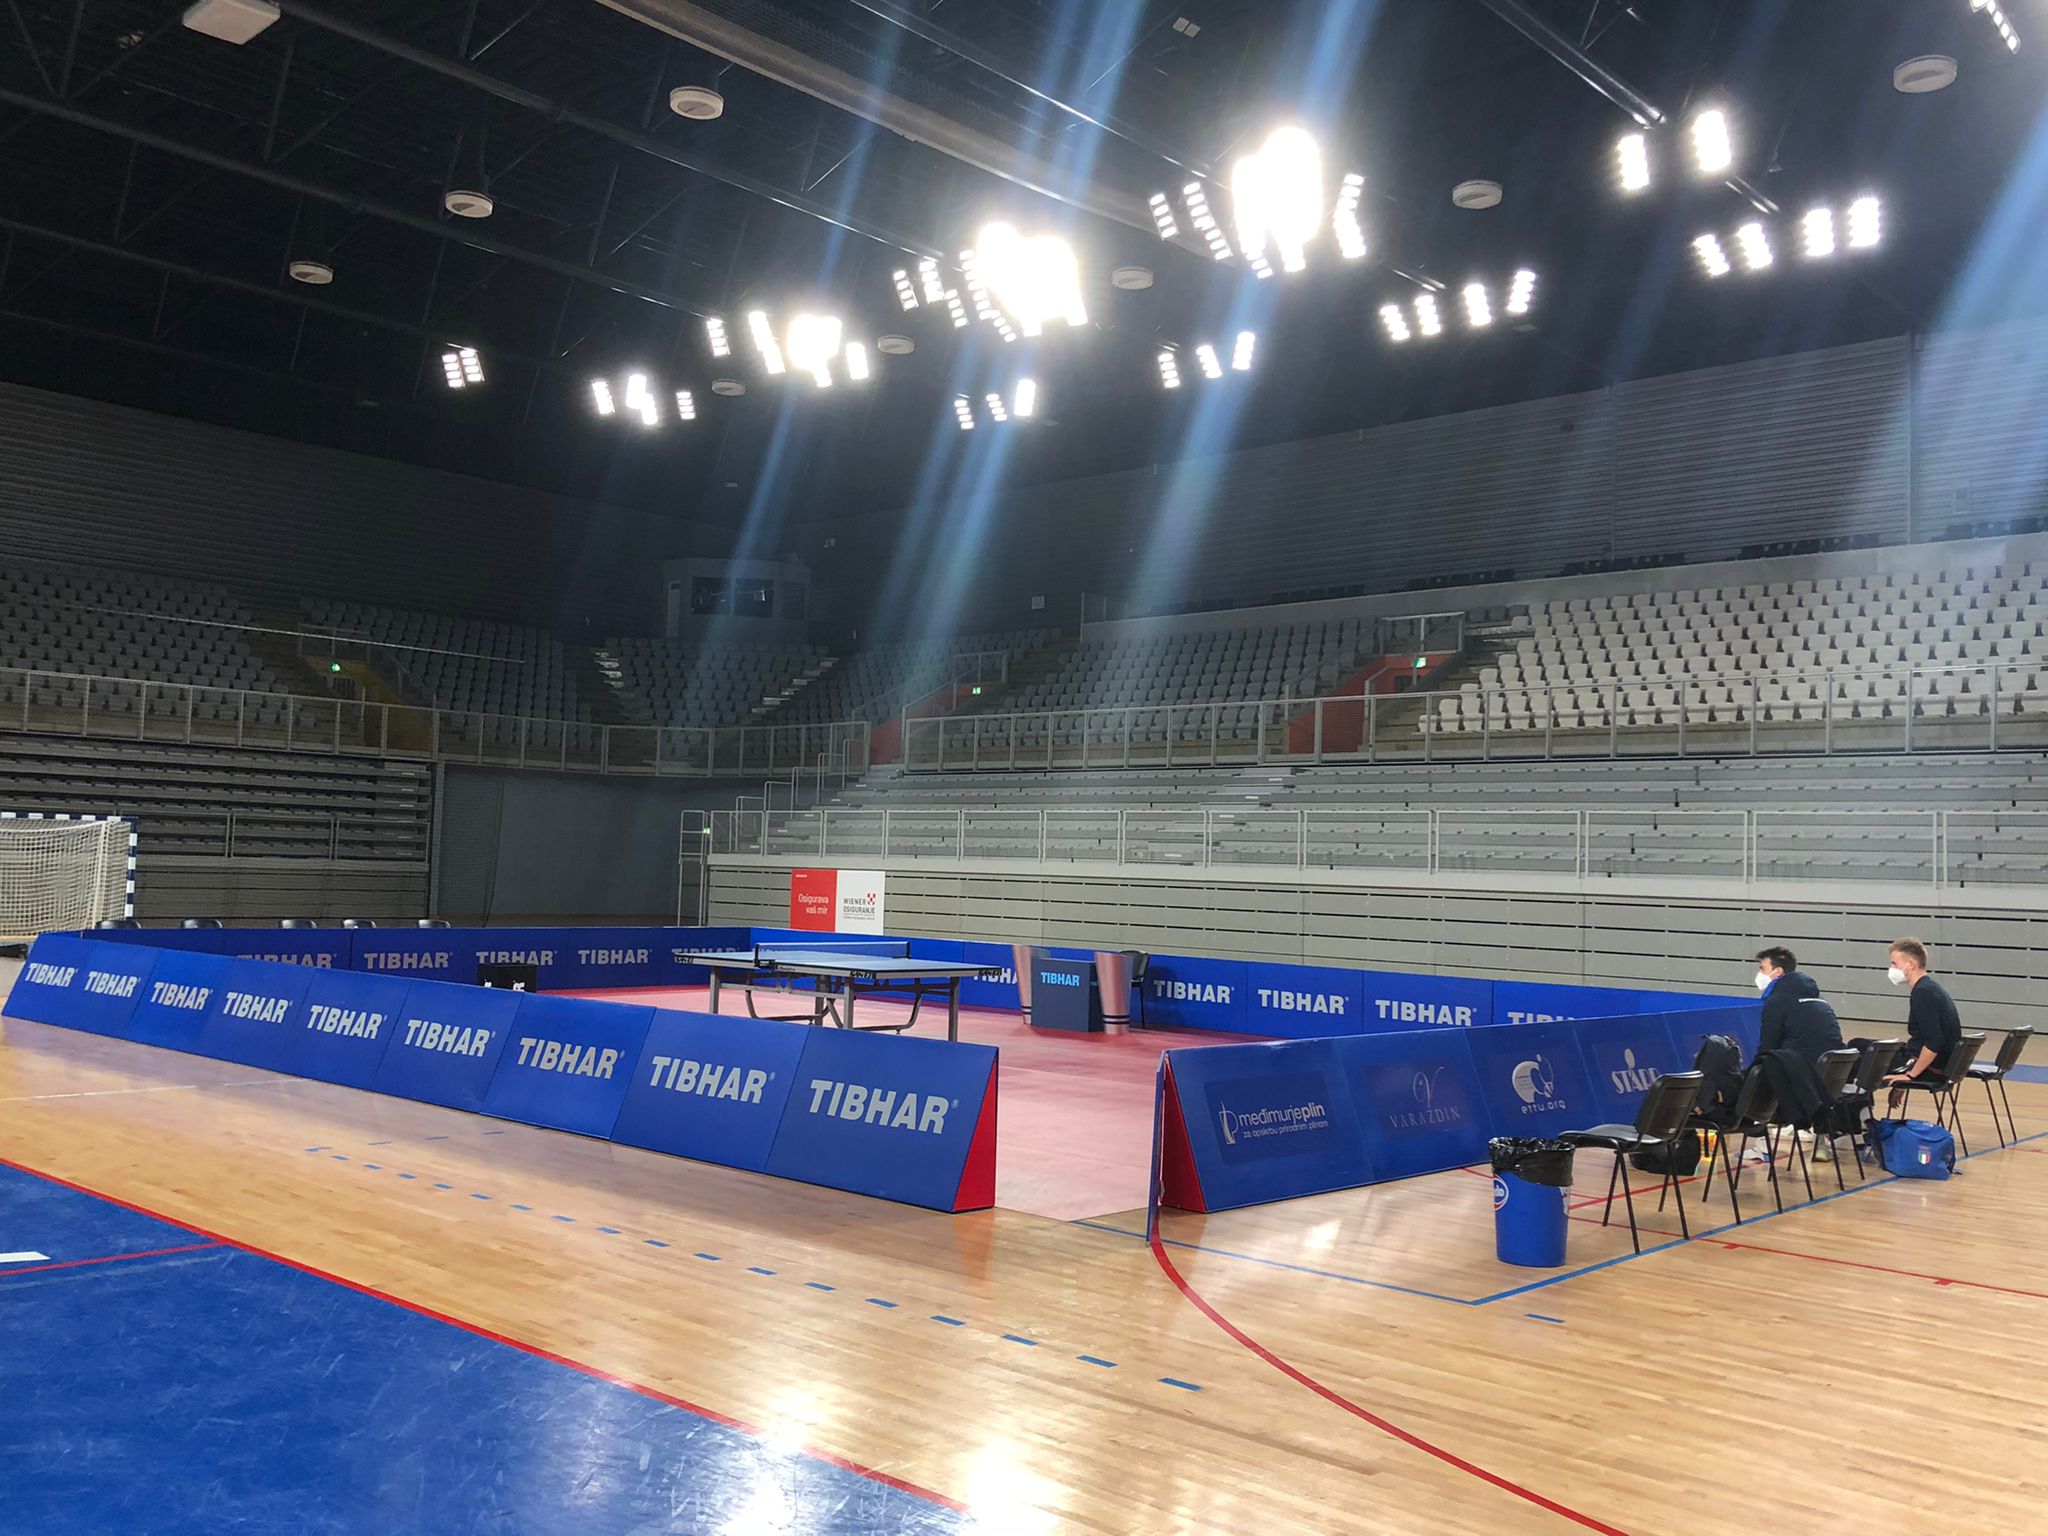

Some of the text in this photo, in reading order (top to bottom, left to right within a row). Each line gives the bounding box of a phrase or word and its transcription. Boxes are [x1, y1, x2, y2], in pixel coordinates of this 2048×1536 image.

[843, 905, 876, 914] OSIGURANJE
[364, 952, 448, 969] TIBHAR
[578, 949, 648, 964] TIBHAR
[24, 963, 75, 987] TIBHAR
[85, 972, 137, 997] TIBHAR
[1040, 972, 1080, 986] TIBHAR
[150, 982, 209, 1009] TIBHAR
[1154, 980, 1231, 1003] TIBHAR
[1258, 990, 1344, 1014] TIBHAR
[223, 992, 288, 1023] TIBHAR
[1376, 1000, 1471, 1026] TIBHAR
[307, 1005, 382, 1039] TIBHAR
[404, 1020, 489, 1057] TIBHAR
[518, 1038, 618, 1079] TIBHAR
[650, 1056, 767, 1103] TIBHAR
[810, 1079, 949, 1134] TIBHAR
